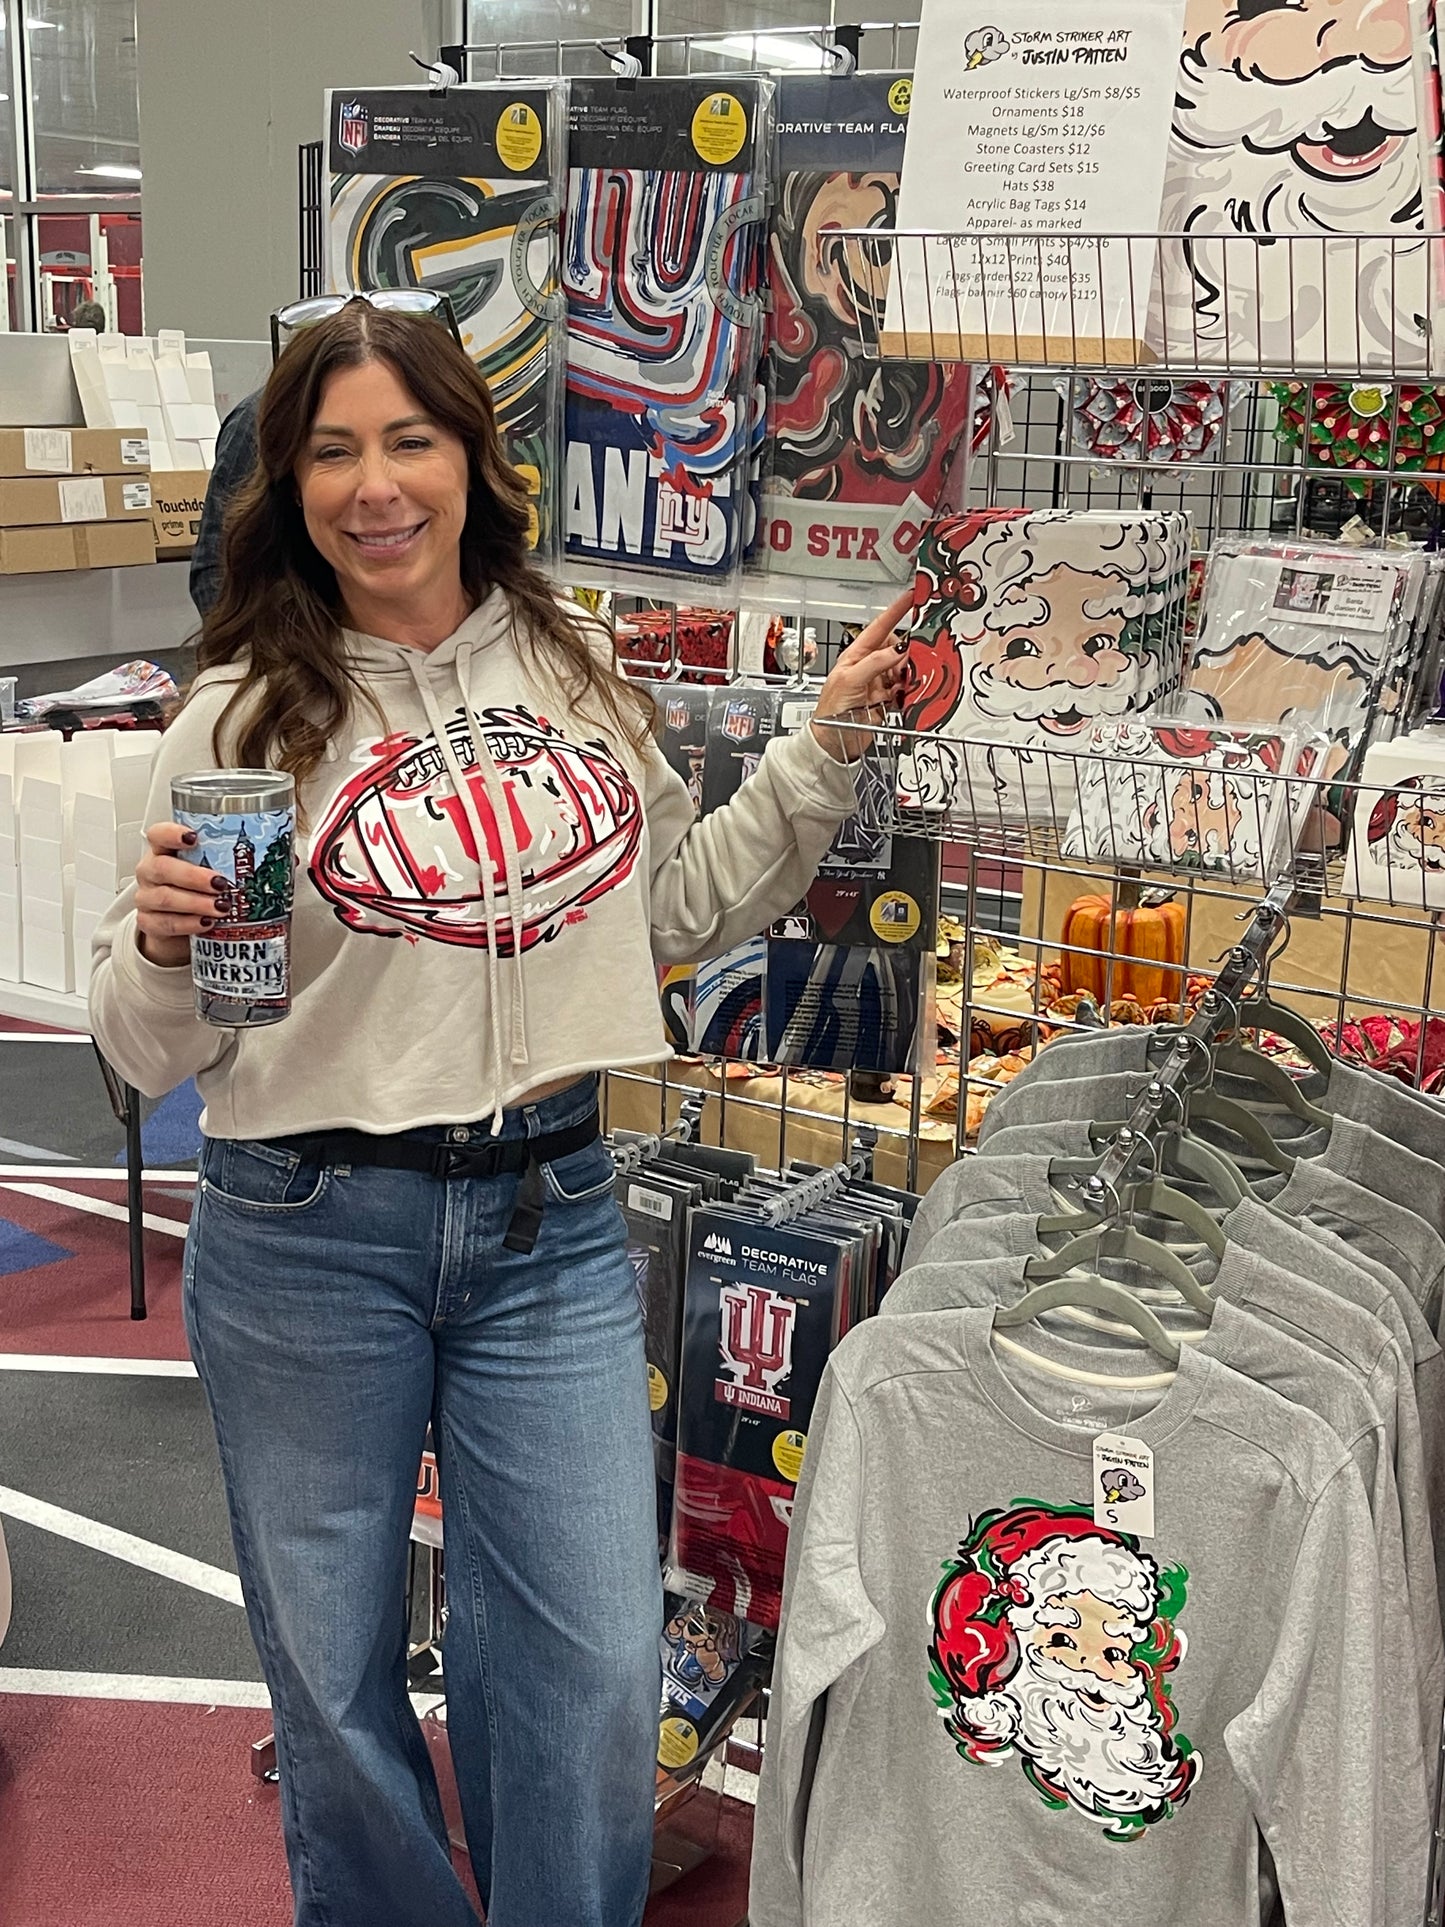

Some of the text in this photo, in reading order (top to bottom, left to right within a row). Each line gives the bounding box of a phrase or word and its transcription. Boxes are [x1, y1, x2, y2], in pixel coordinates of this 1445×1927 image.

[1011, 30, 1132, 44] STORM STRIKER ART
[1022, 48, 1069, 65] JUSTIN
[1072, 47, 1127, 65] PATTEN
[943, 87, 1141, 101] Waterproof Stickers Lg/Sm $8/$5
[992, 105, 1084, 119] Ornaments $18
[344, 120, 368, 149] NFL
[838, 123, 874, 133] TEAM
[880, 123, 905, 133] FLA
[968, 124, 1105, 138] Magnets Lg/Sm $12/$6
[976, 143, 1090, 155] Stone Coasters $12
[964, 161, 1099, 175] Greeting Card Sets $15
[1003, 180, 1054, 192] Hats $38
[967, 198, 1086, 213] Acrylic Bag Tags $14
[967, 216, 1082, 229] Apparel- as marked
[936, 236, 967, 248] Lage
[1047, 253, 1070, 267] $40
[1014, 271, 1033, 283] $22
[1071, 272, 1091, 284] $35
[727, 715, 755, 739] NFL
[196, 940, 266, 960] AUBURN
[697, 1250, 737, 1266] evergreen
[741, 1245, 828, 1275] DECORATIVE
[741, 1258, 817, 1286] TEAM FLAG
[738, 1389, 781, 1413] INDIANA
[1106, 1509, 1118, 1524] S
